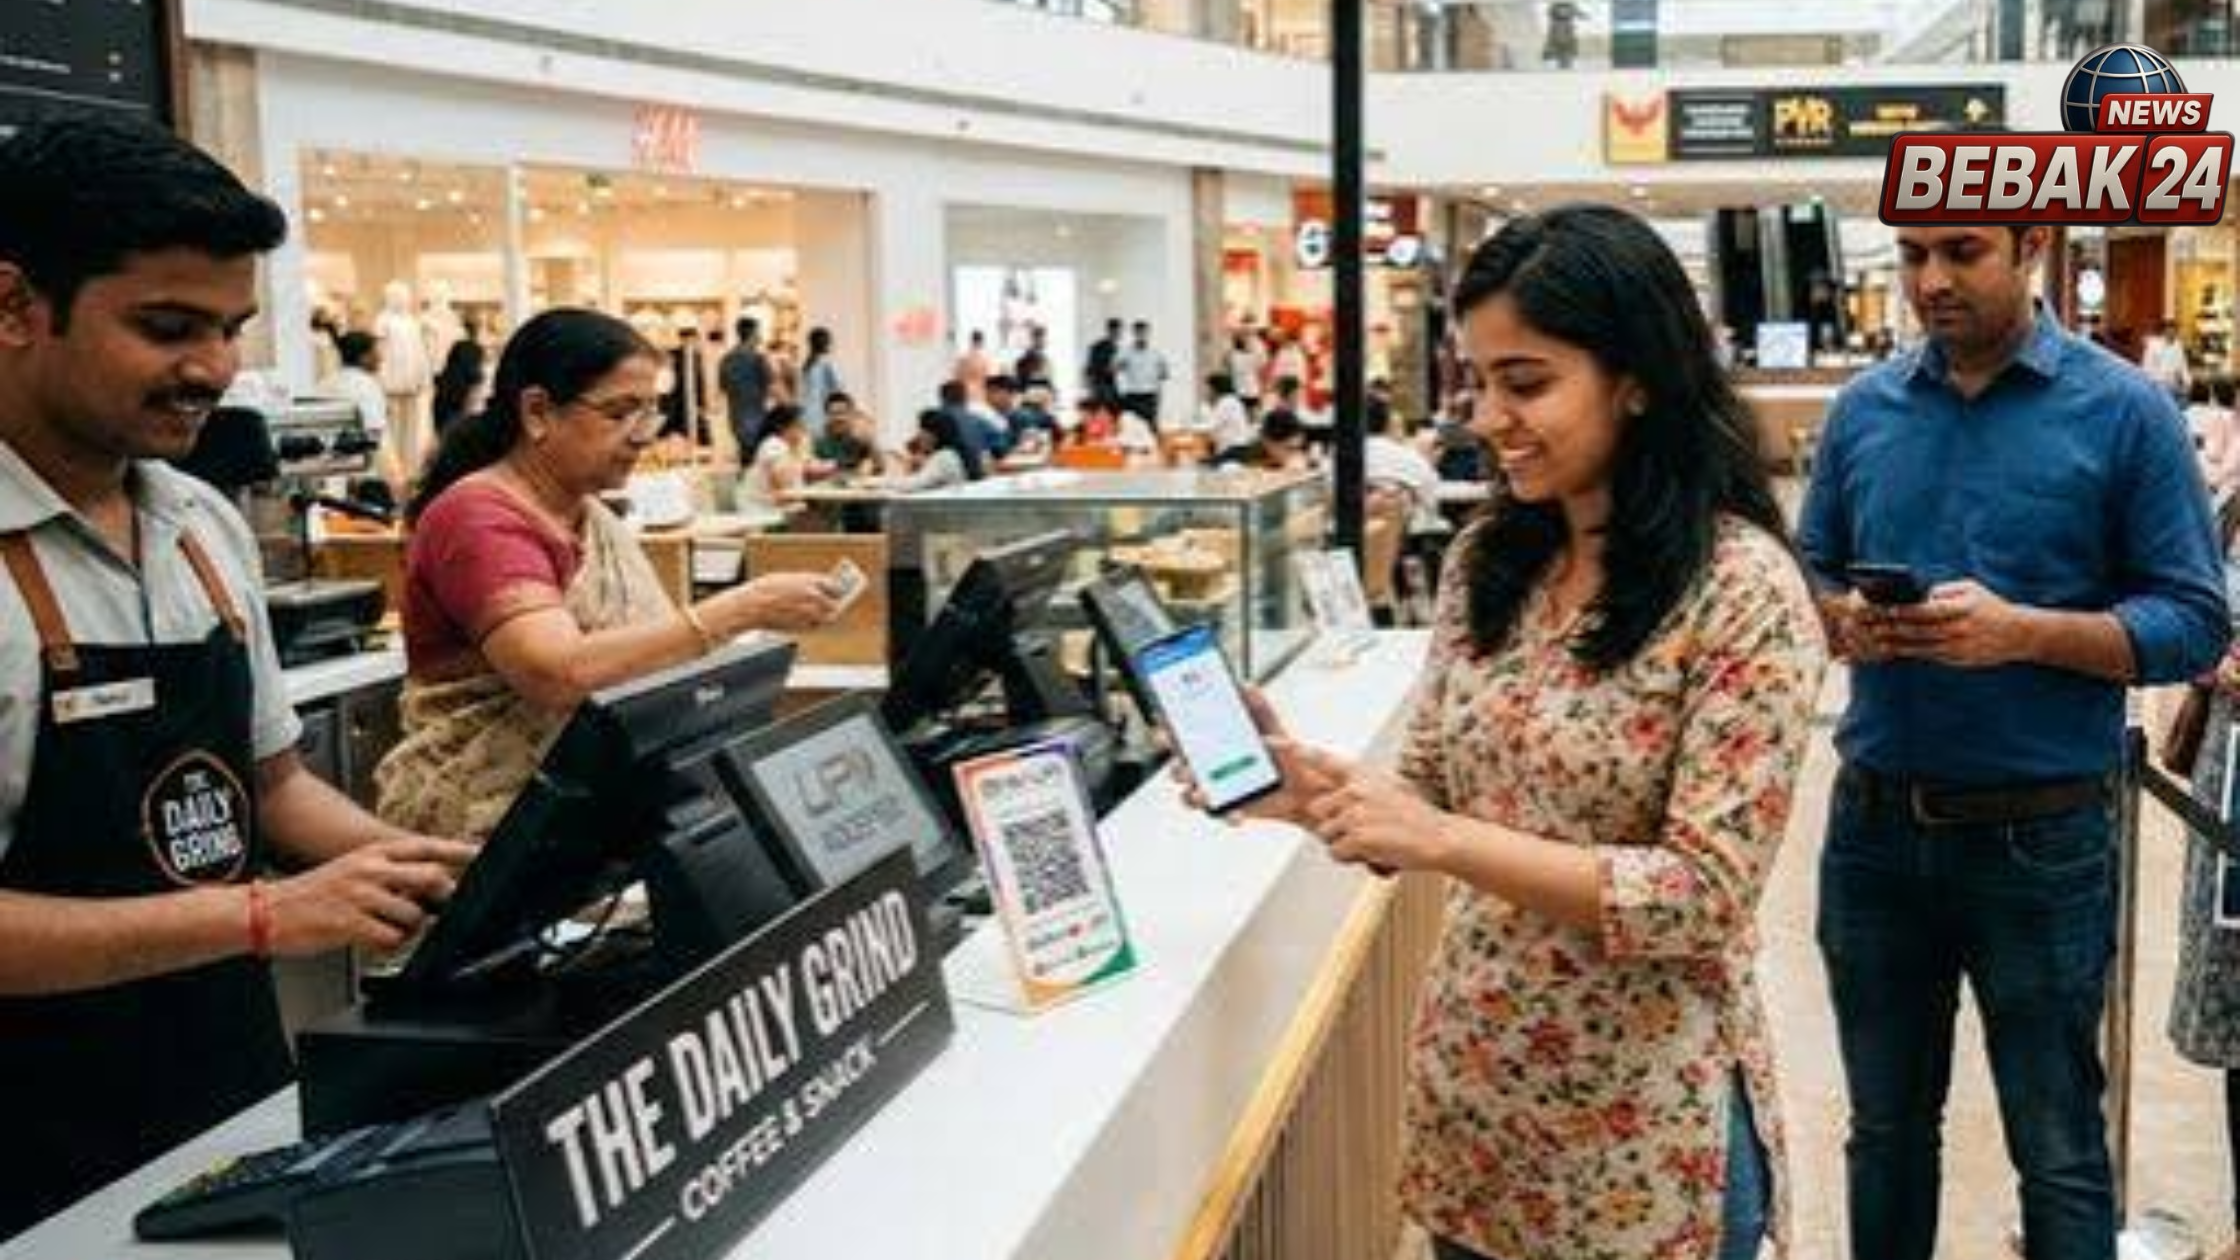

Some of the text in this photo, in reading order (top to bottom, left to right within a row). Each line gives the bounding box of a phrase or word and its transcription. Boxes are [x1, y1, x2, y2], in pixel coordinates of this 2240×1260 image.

[163, 786, 233, 837] DAILY
[546, 890, 918, 1228] THE DAILY GRIND
[679, 1114, 786, 1220] COFFEE
[800, 1033, 878, 1119] SNACK
